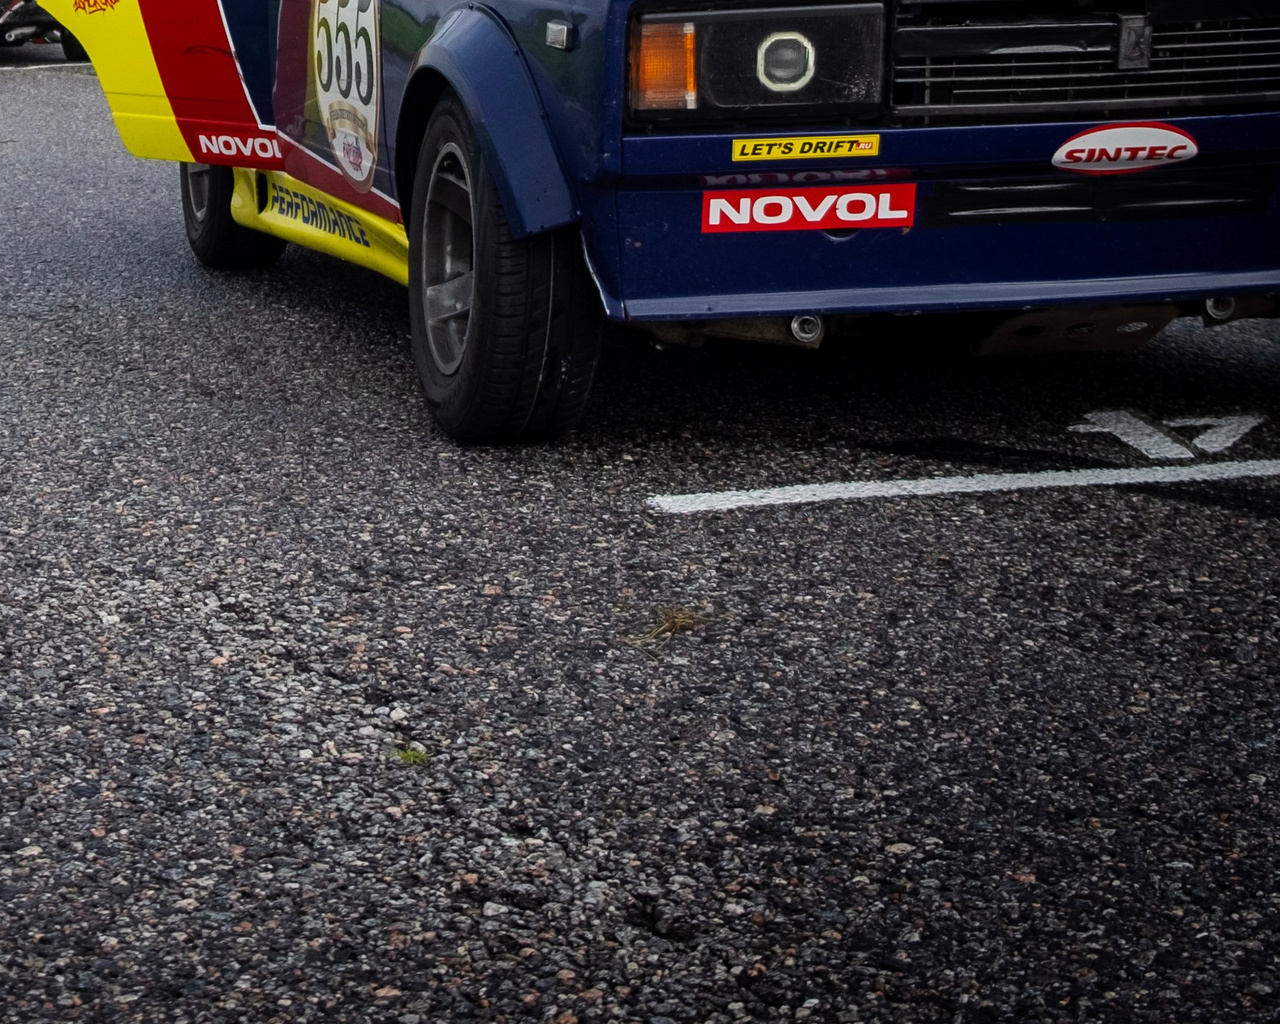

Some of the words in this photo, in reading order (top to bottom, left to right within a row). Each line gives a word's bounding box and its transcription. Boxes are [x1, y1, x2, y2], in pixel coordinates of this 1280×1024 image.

[738, 141, 794, 157] LET'S
[1060, 144, 1188, 164] SINTEC
[270, 182, 371, 248] PERFORMANCE
[708, 192, 908, 225] NOVOL
